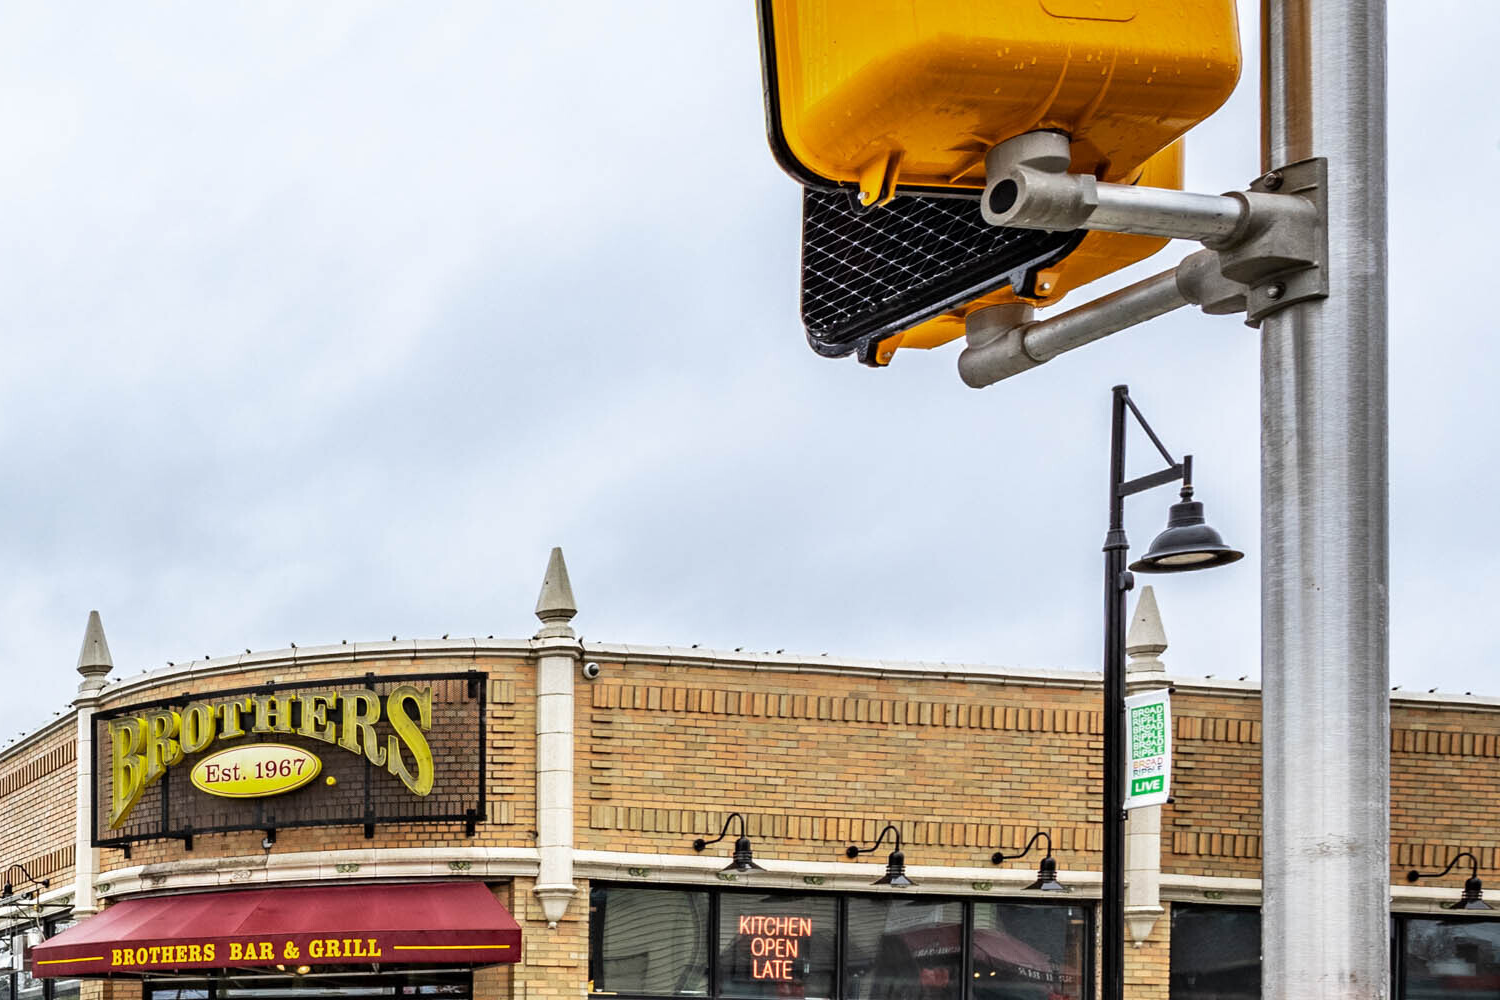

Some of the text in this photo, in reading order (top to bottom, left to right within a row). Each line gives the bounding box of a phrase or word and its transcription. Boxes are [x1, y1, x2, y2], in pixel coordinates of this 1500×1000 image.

[108, 685, 435, 830] BROTHERS
[204, 758, 305, 783] Est. 1967
[1135, 780, 1161, 793] LIVE
[739, 915, 812, 937] KITCHEN
[111, 939, 382, 966] BROTHERS BAR & GRILL
[751, 937, 798, 958] OPEN
[753, 959, 793, 980] LATE
